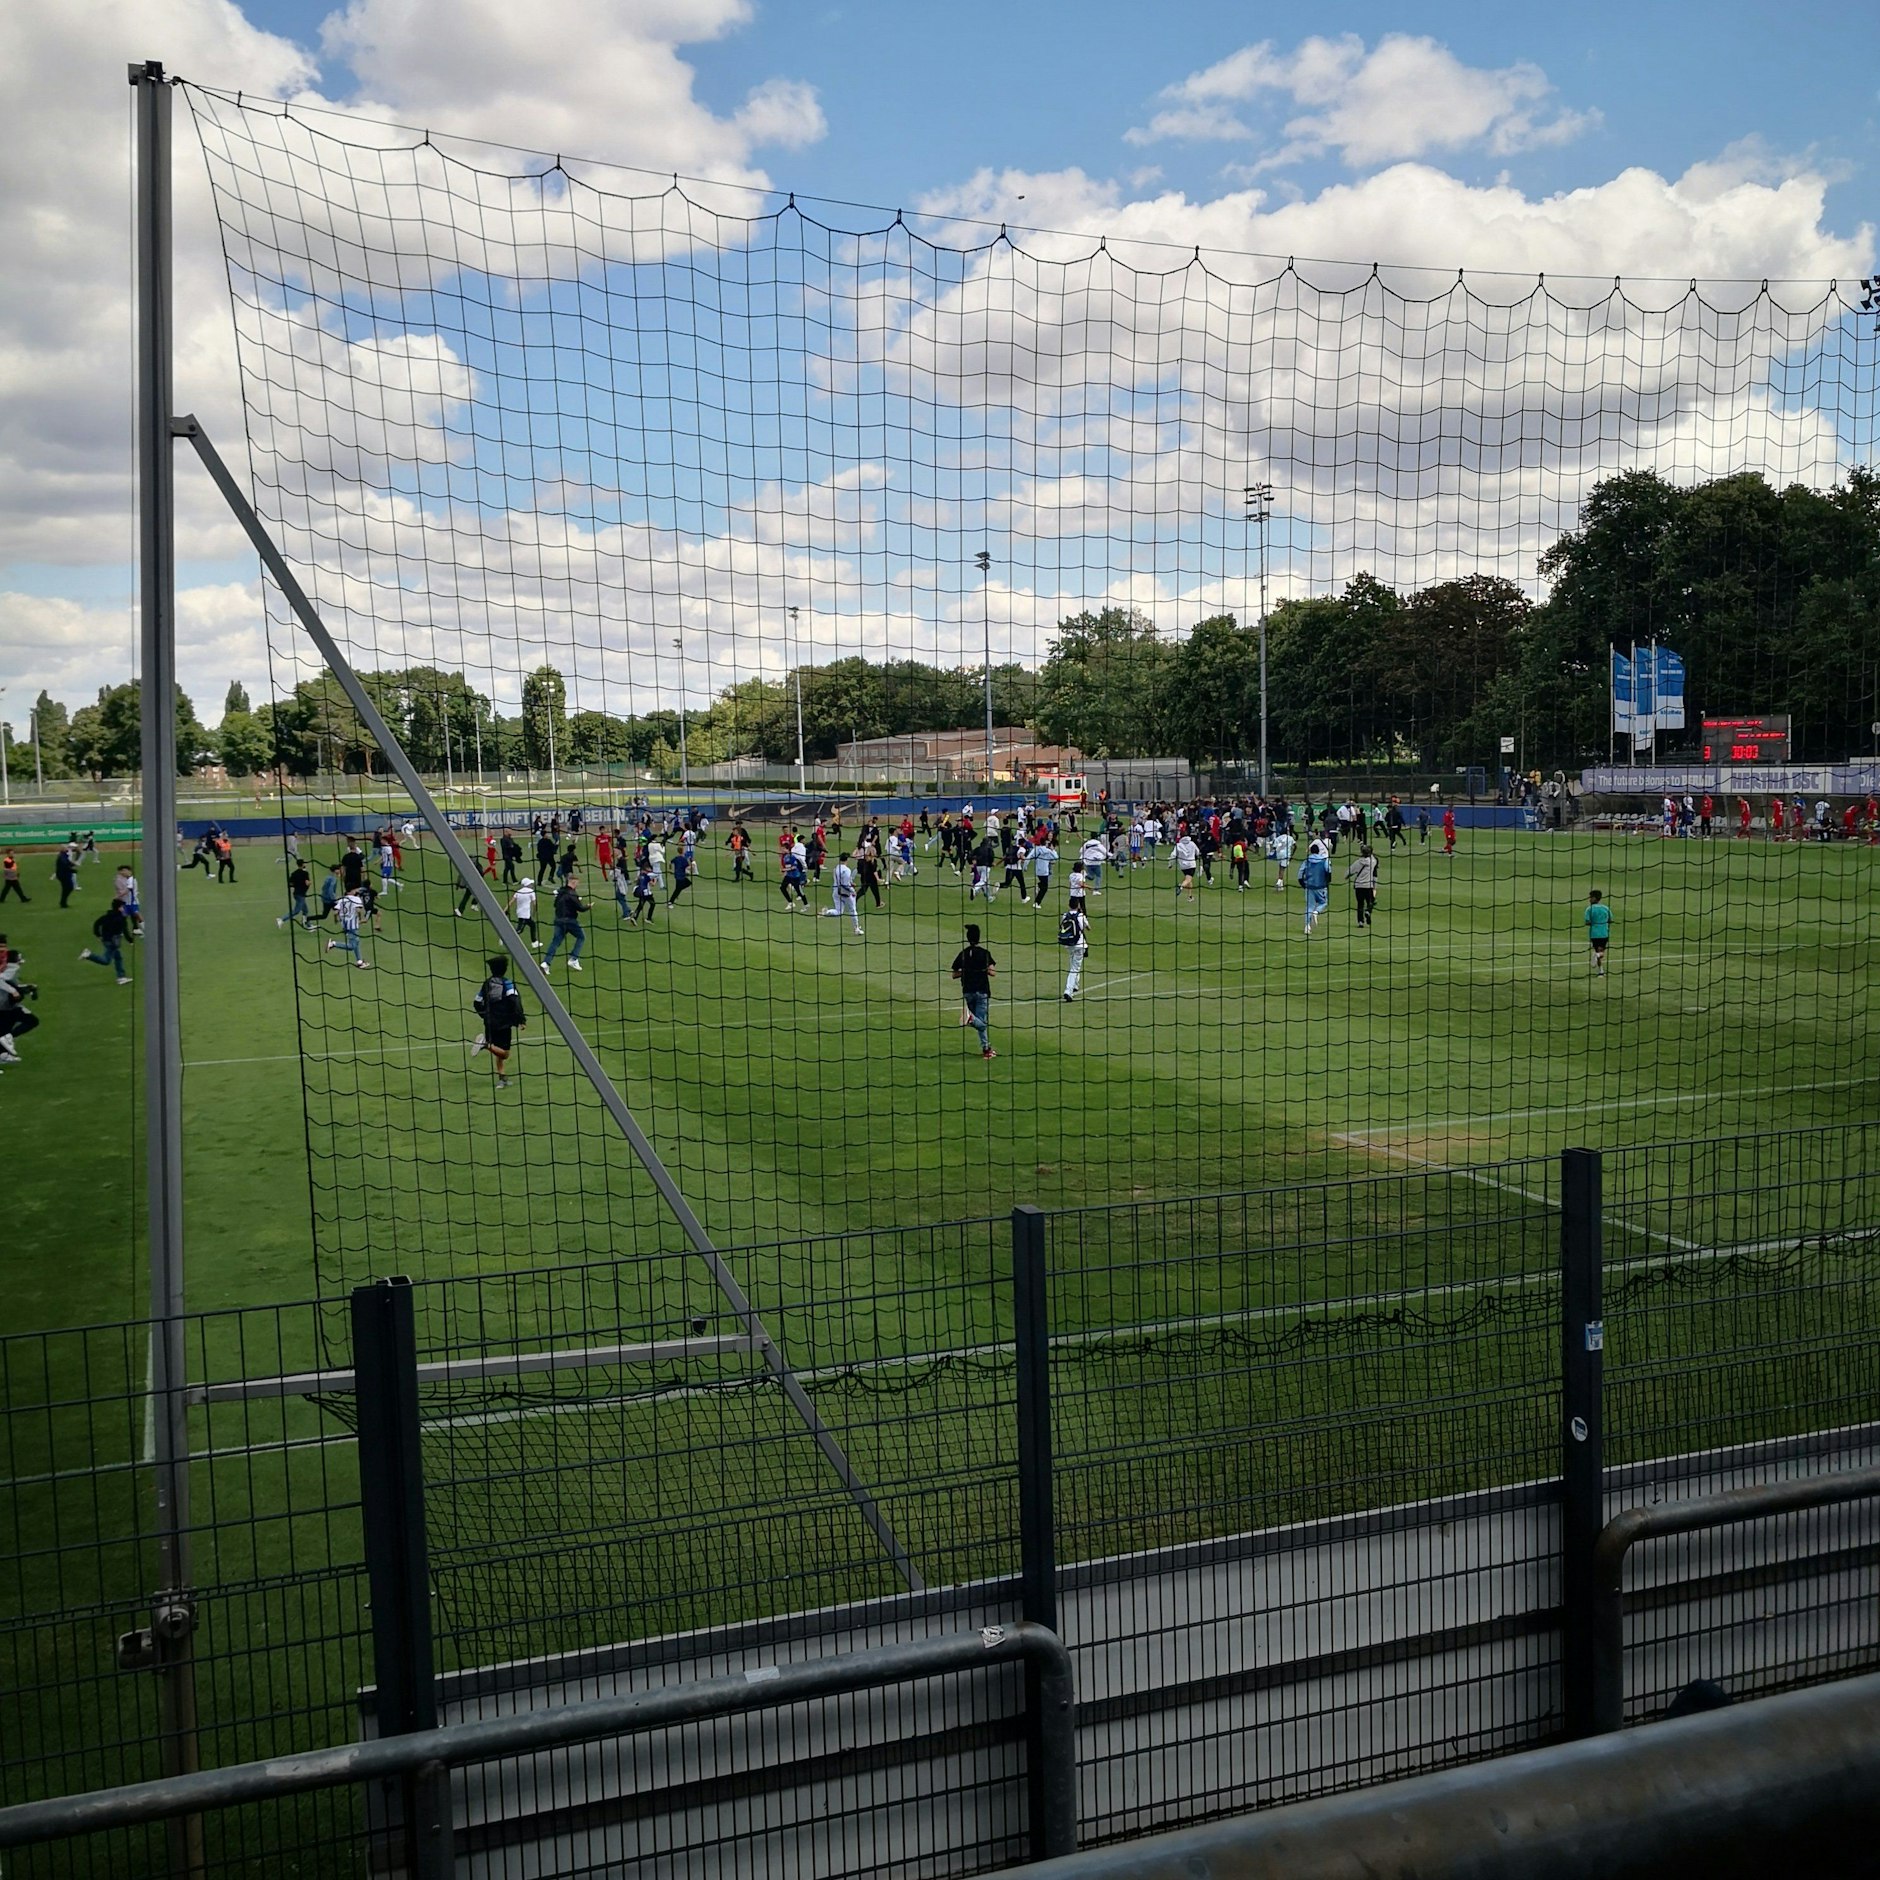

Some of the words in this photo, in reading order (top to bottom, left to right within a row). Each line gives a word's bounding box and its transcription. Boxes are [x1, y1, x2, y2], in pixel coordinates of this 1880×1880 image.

[1598, 775, 1612, 786] The
[1613, 775, 1638, 787] future
[1638, 775, 1670, 789] belongs
[1671, 776, 1681, 786] to
[1681, 774, 1715, 787] BERLIN
[1732, 772, 1789, 789] HERTHA
[1791, 772, 1820, 789] BSC
[448, 813, 470, 826] DIE
[472, 812, 530, 825] ZUKUNFT
